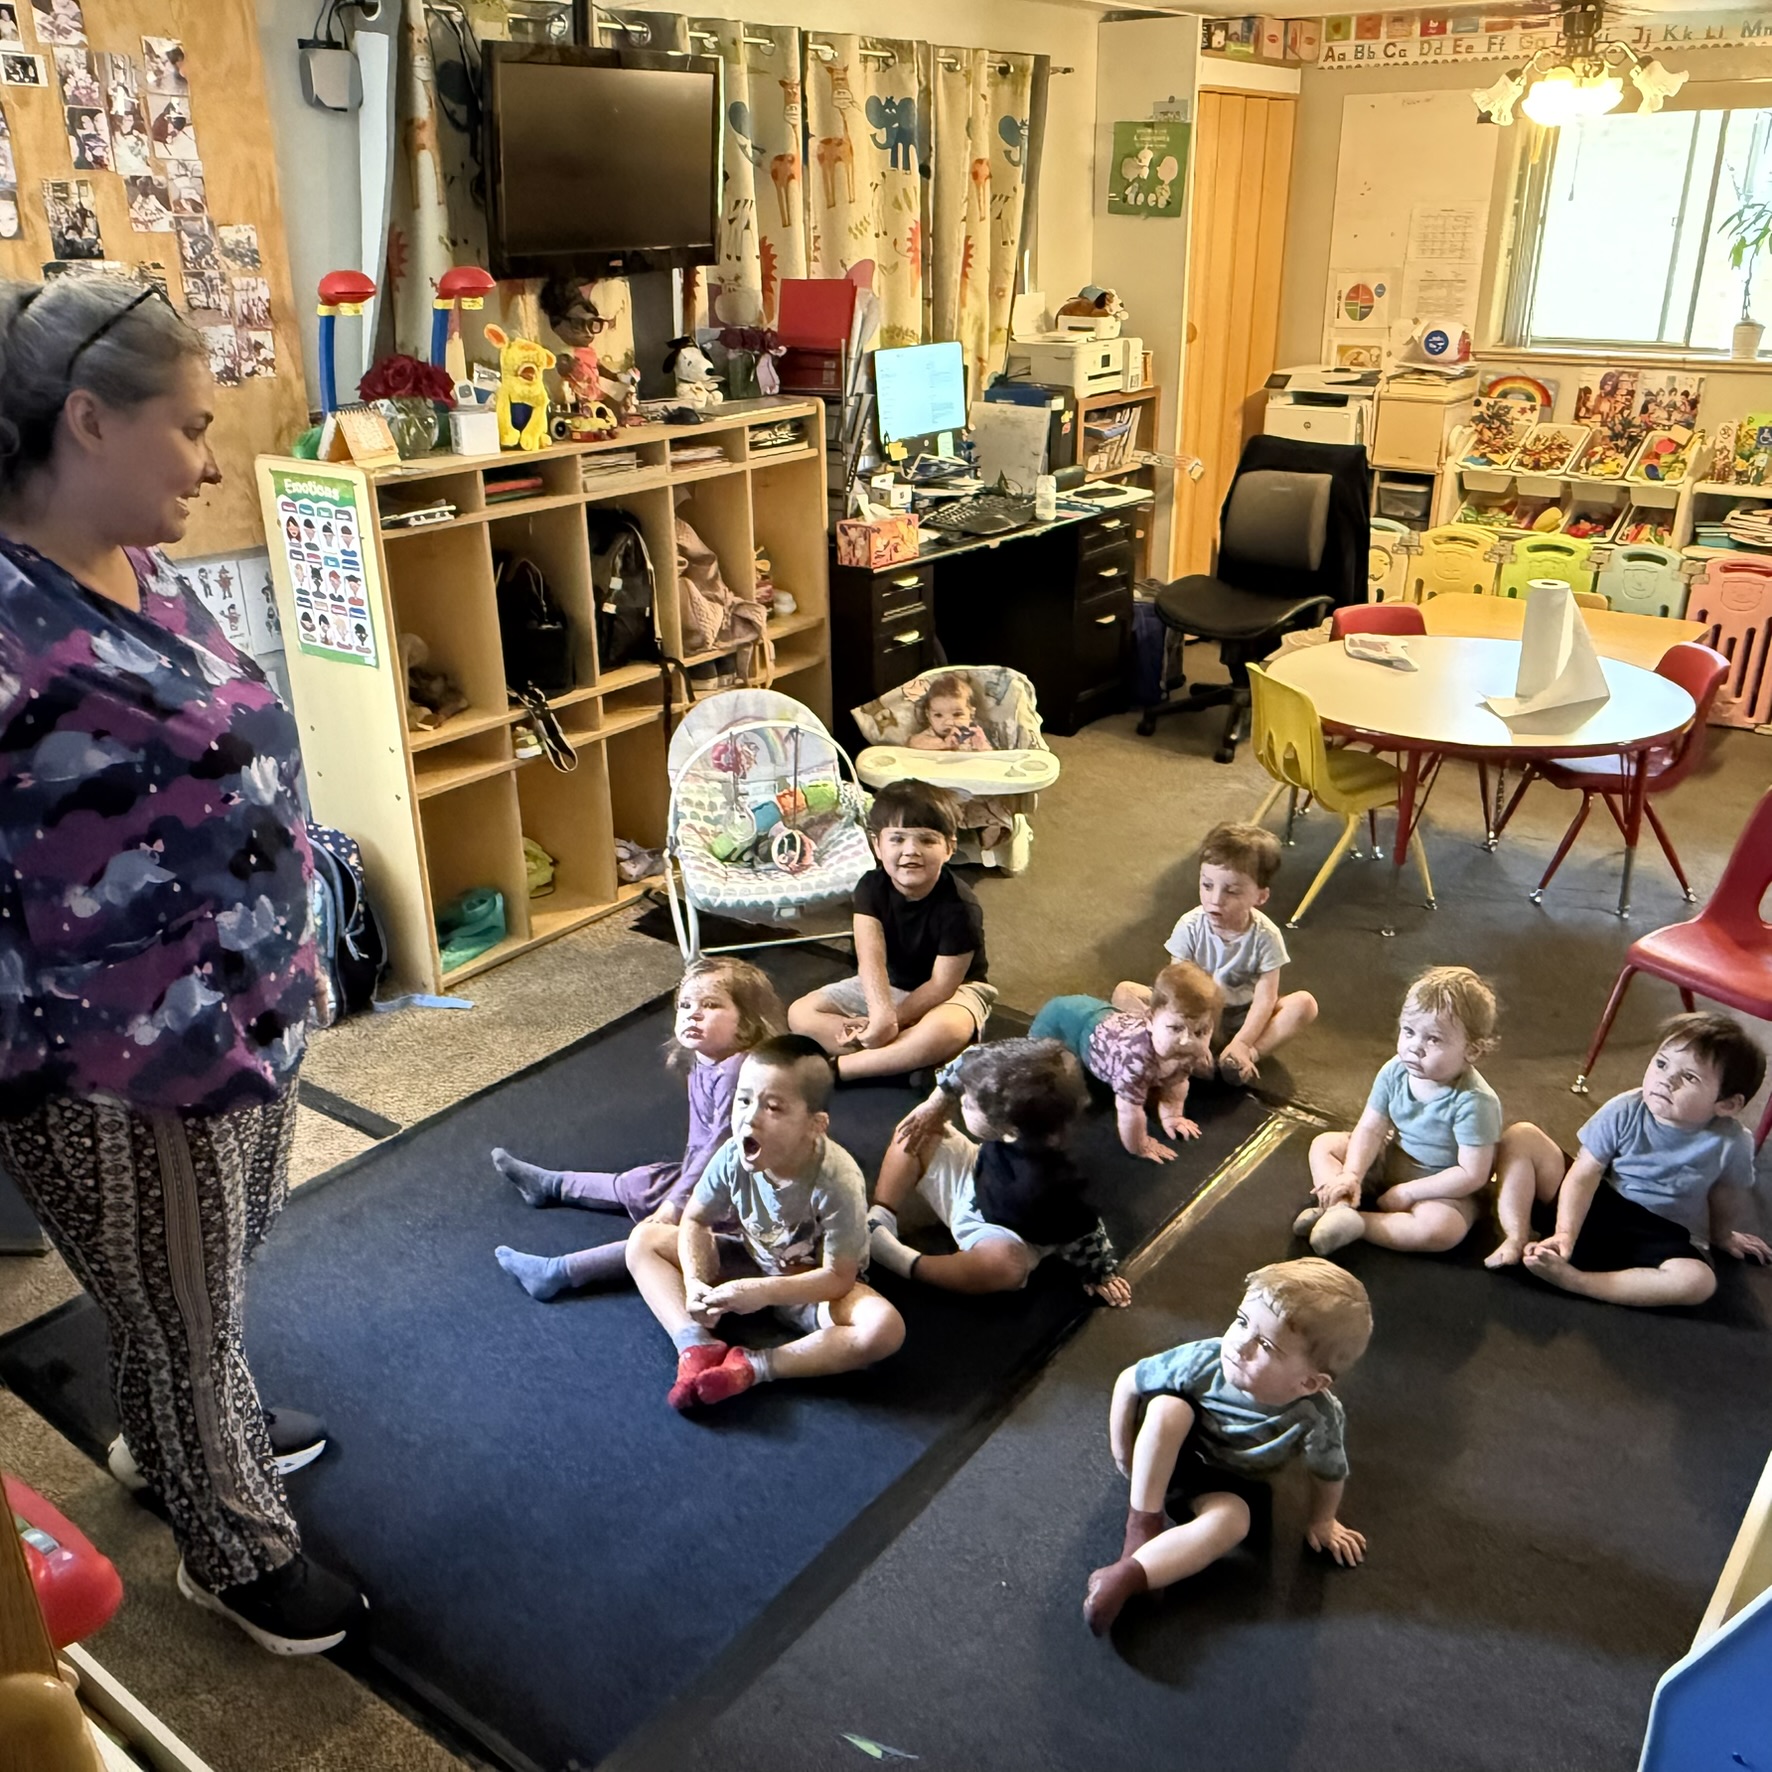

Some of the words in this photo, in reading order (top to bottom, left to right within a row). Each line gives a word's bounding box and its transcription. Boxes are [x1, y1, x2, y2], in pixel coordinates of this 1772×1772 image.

[1419, 40, 1443, 56] Dd
[1453, 38, 1474, 54] Ee
[1663, 24, 1692, 41] Kk
